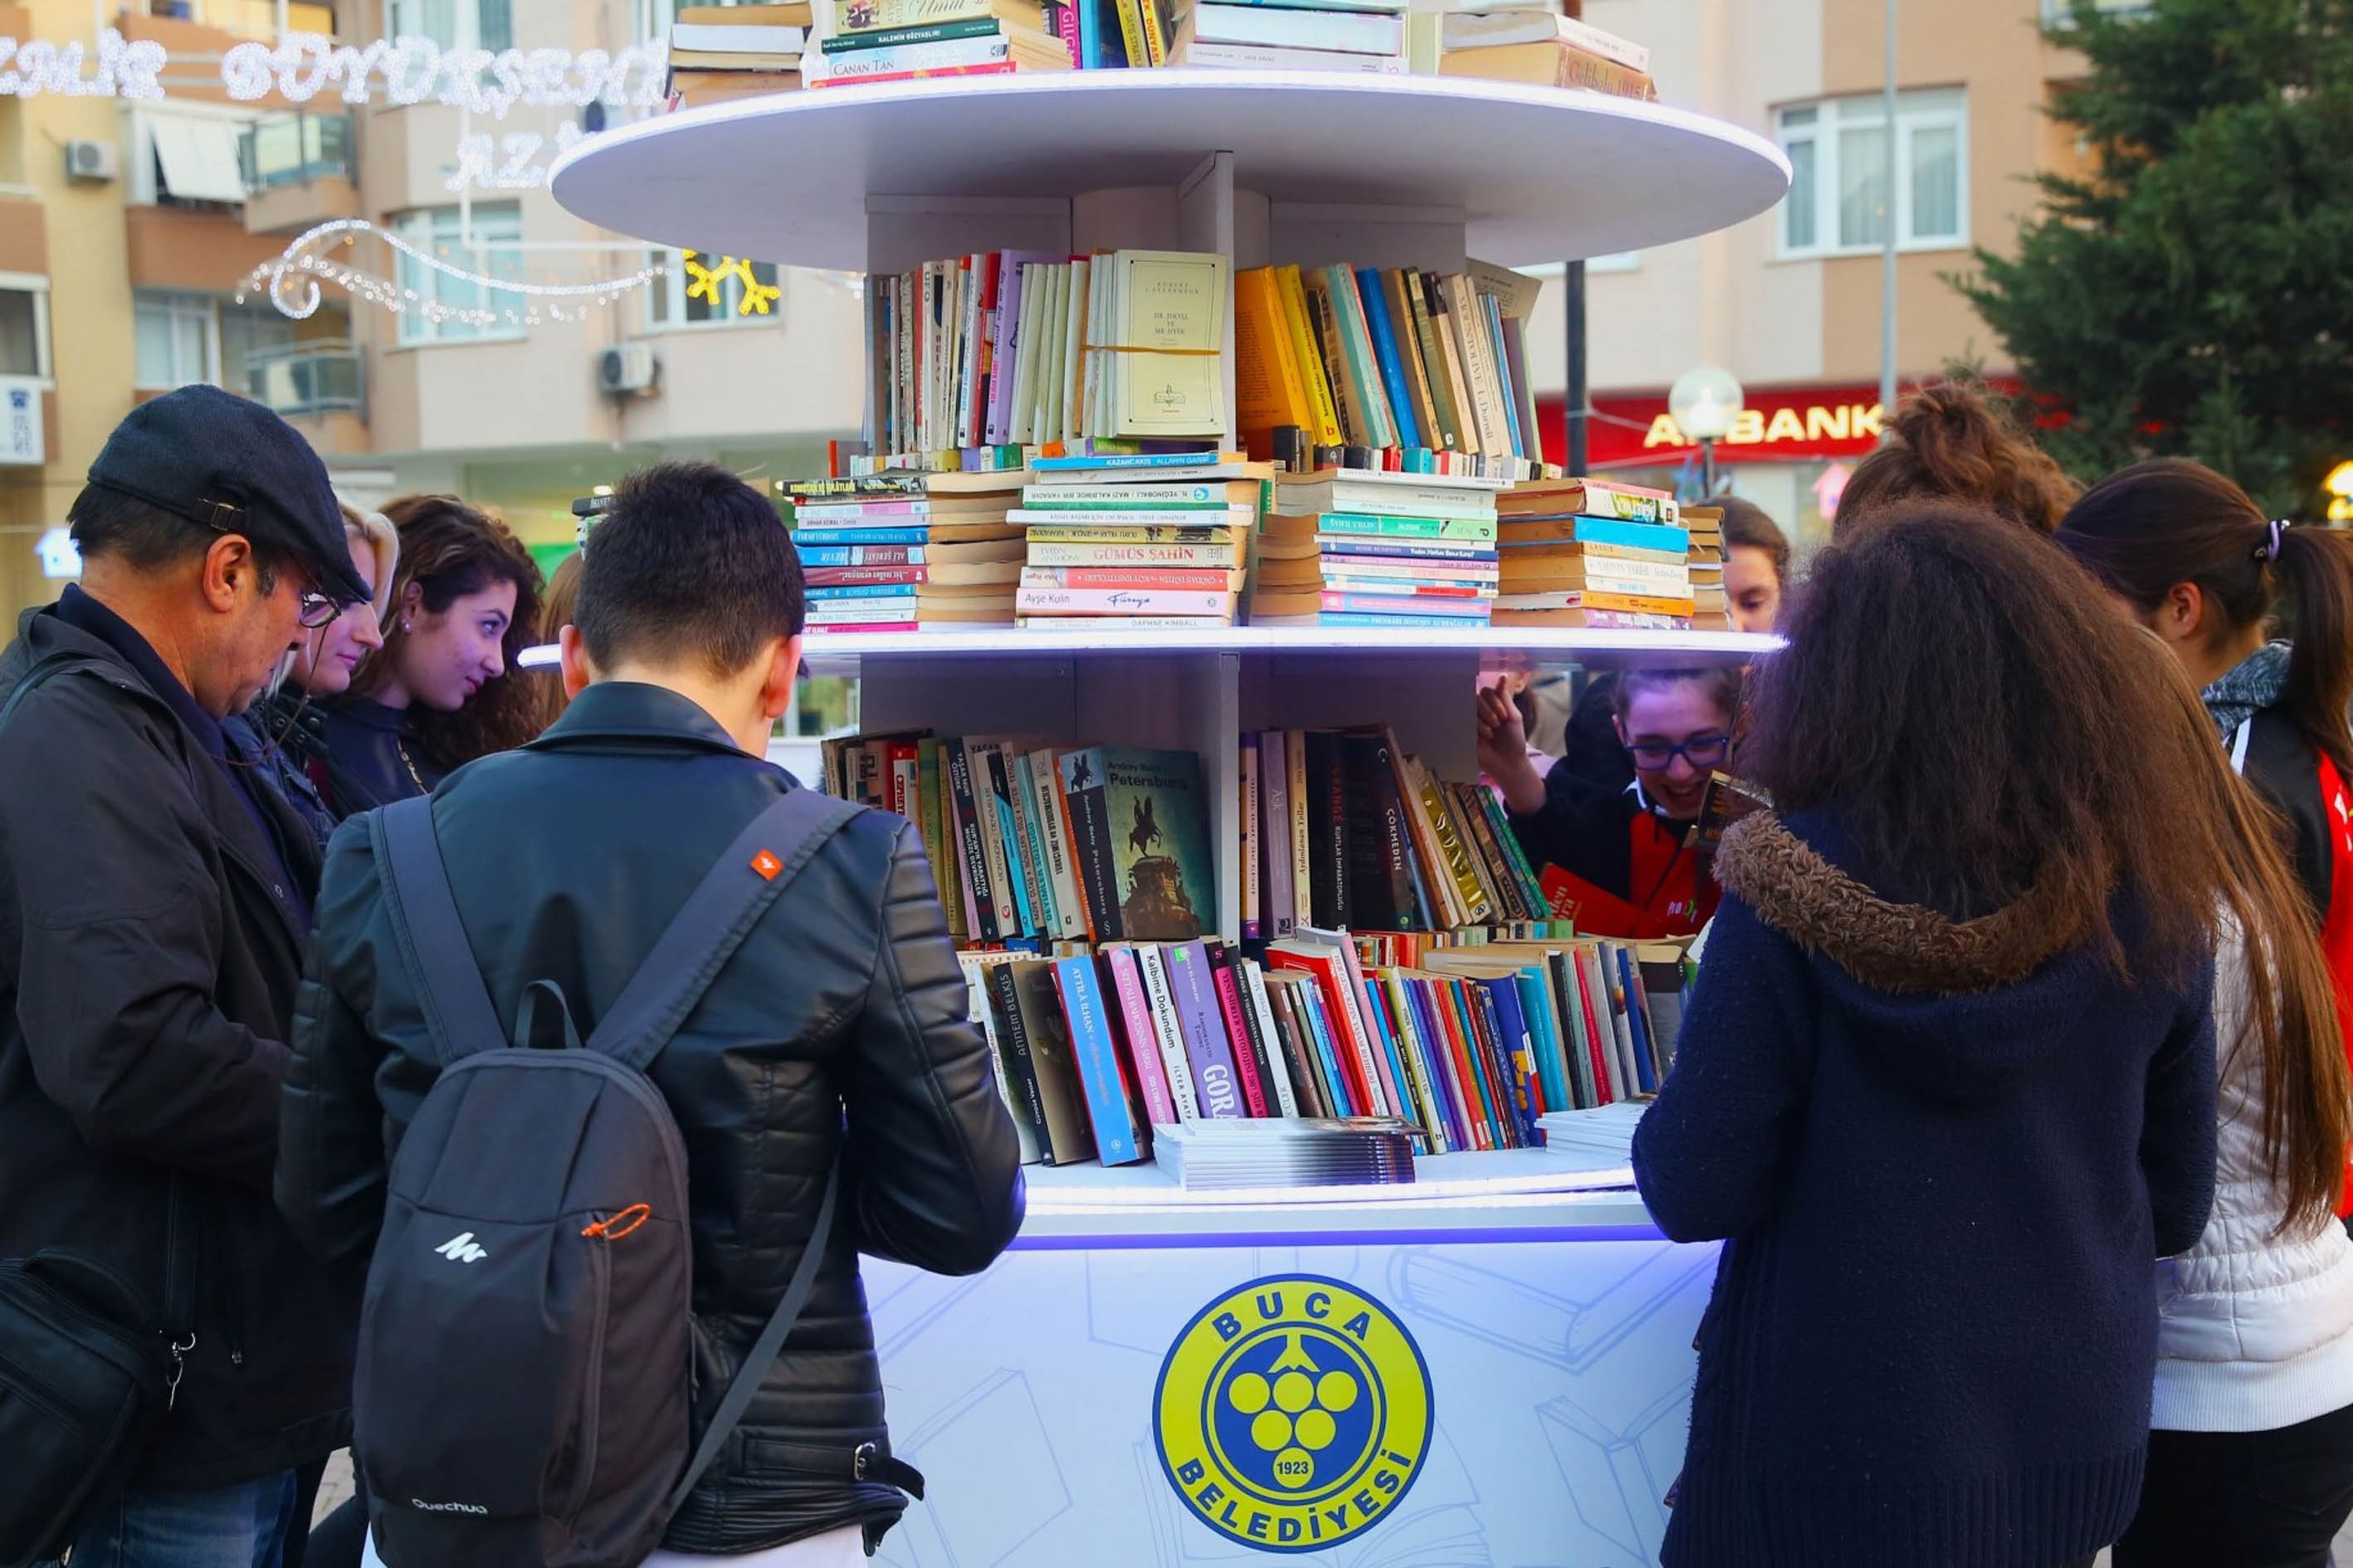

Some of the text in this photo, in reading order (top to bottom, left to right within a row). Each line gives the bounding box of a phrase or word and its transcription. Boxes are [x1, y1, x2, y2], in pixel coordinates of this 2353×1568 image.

[832, 56, 894, 76] CANAN TAN
[1643, 403, 1885, 448] ABANK
[1149, 546, 1194, 562] ŞAHİN
[1025, 593, 1070, 604] Ayşe Kulin
[1107, 760, 1138, 770] Andrey
[1109, 772, 1189, 790] Petersburg
[1385, 808, 1403, 872] ÇÖKMEDEN
[1092, 849, 1108, 915] Petersburg
[1145, 954, 1176, 1049] Kalbime Dokundum
[1212, 1291, 1370, 1342] BUCA
[1277, 1462, 1309, 1477] 1923
[1177, 1448, 1412, 1542] BELEDİYESİ
[413, 1497, 489, 1515] Quechua
